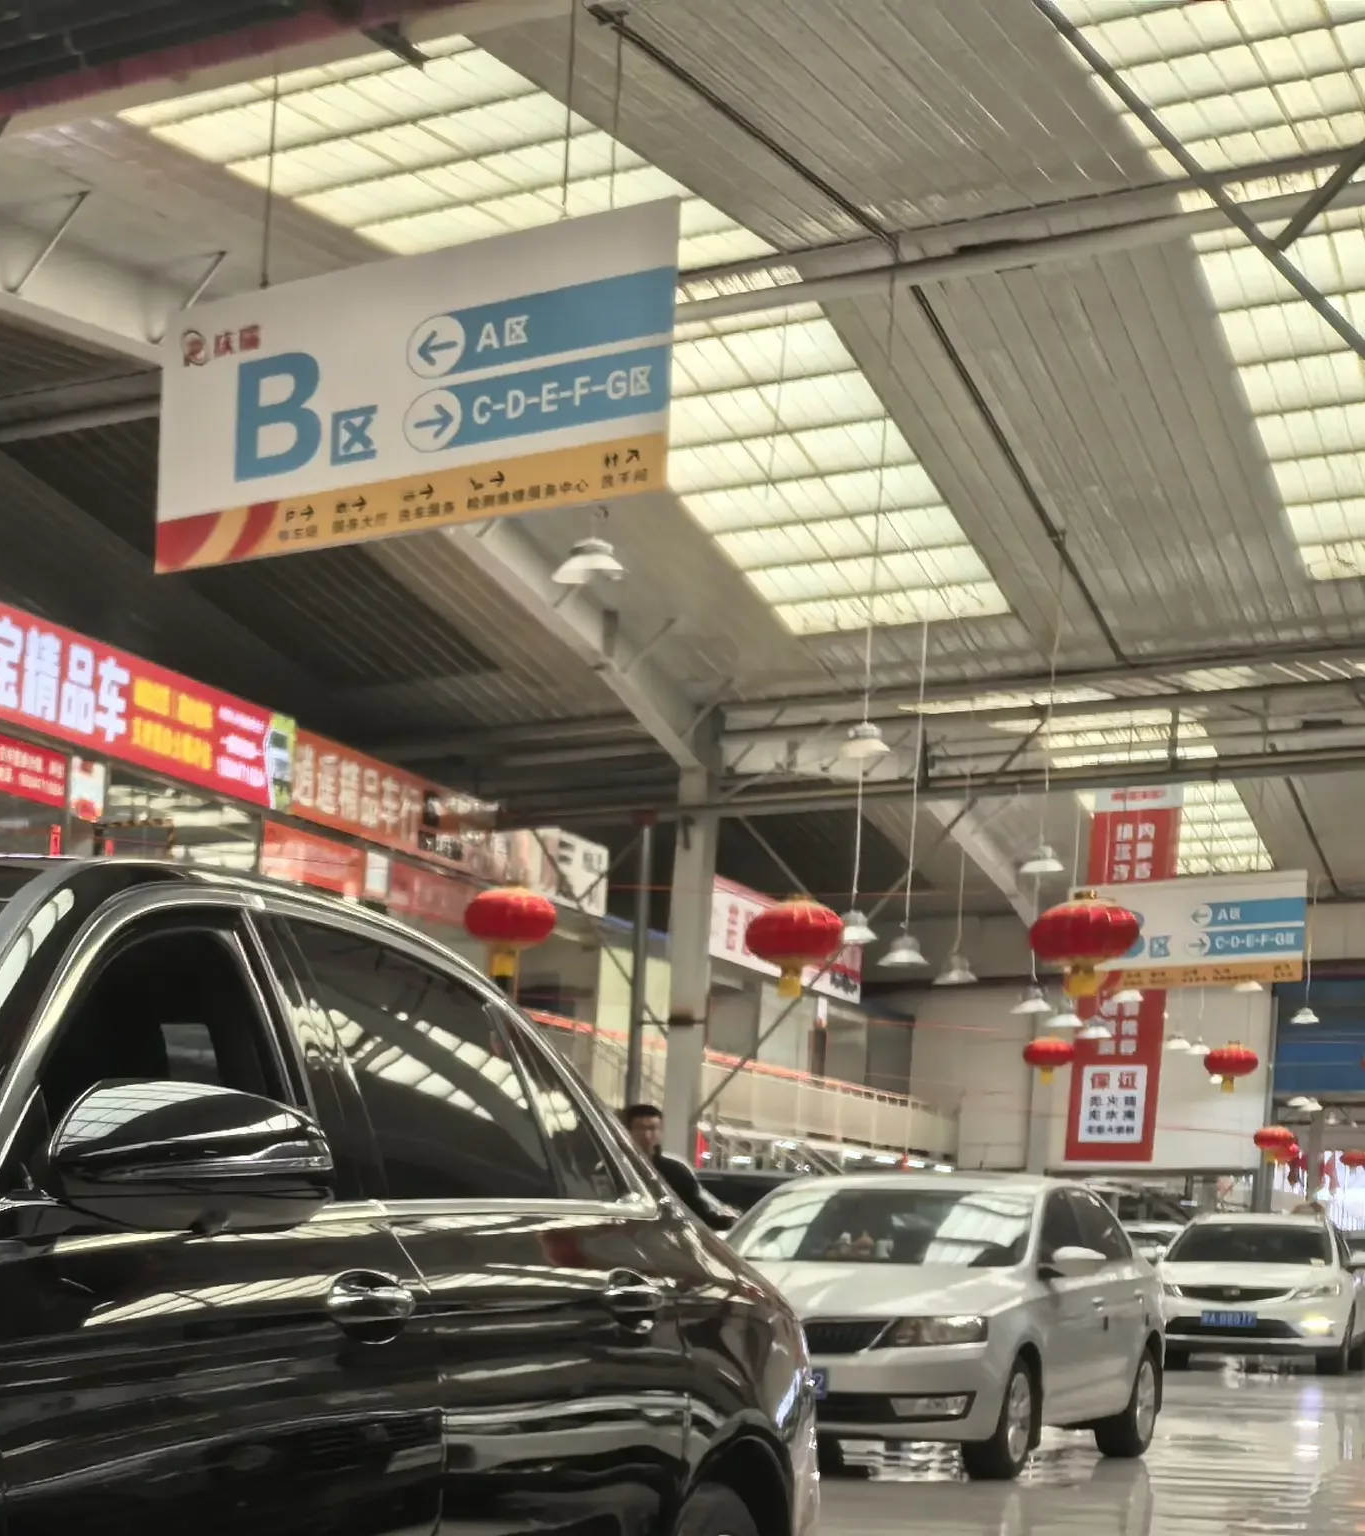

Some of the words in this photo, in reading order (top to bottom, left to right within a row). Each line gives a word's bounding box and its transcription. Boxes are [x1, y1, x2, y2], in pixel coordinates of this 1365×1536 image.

[475, 315, 530, 352] A区
[235, 352, 378, 482] B区
[472, 366, 652, 425] C-D-E-F-G区
